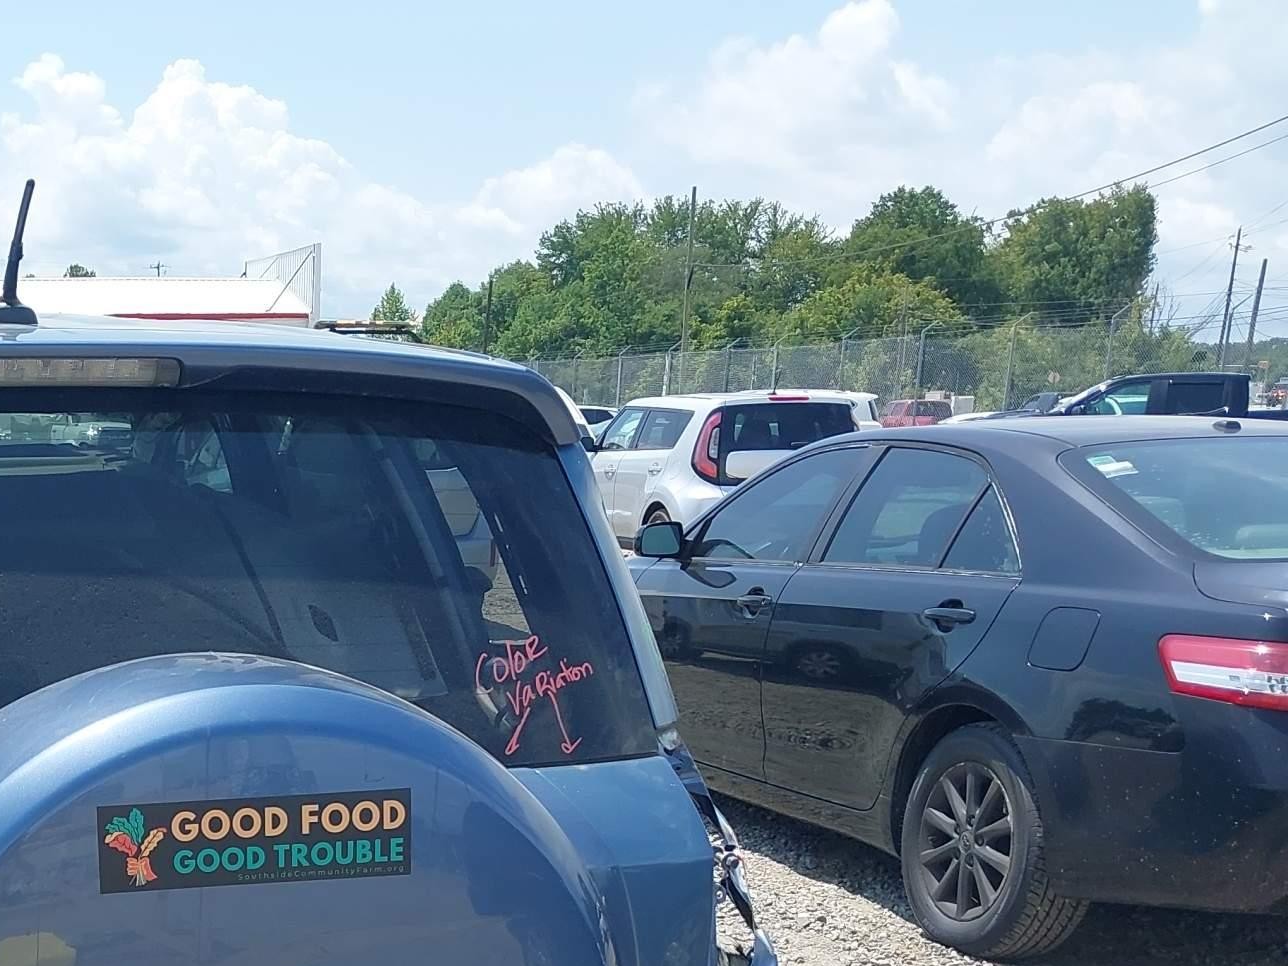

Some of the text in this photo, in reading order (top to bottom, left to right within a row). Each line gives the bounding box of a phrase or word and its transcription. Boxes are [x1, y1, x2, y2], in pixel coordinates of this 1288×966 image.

[170, 799, 407, 843] GOOD FOOD
[172, 838, 406, 875] GOOD TROUBLE
